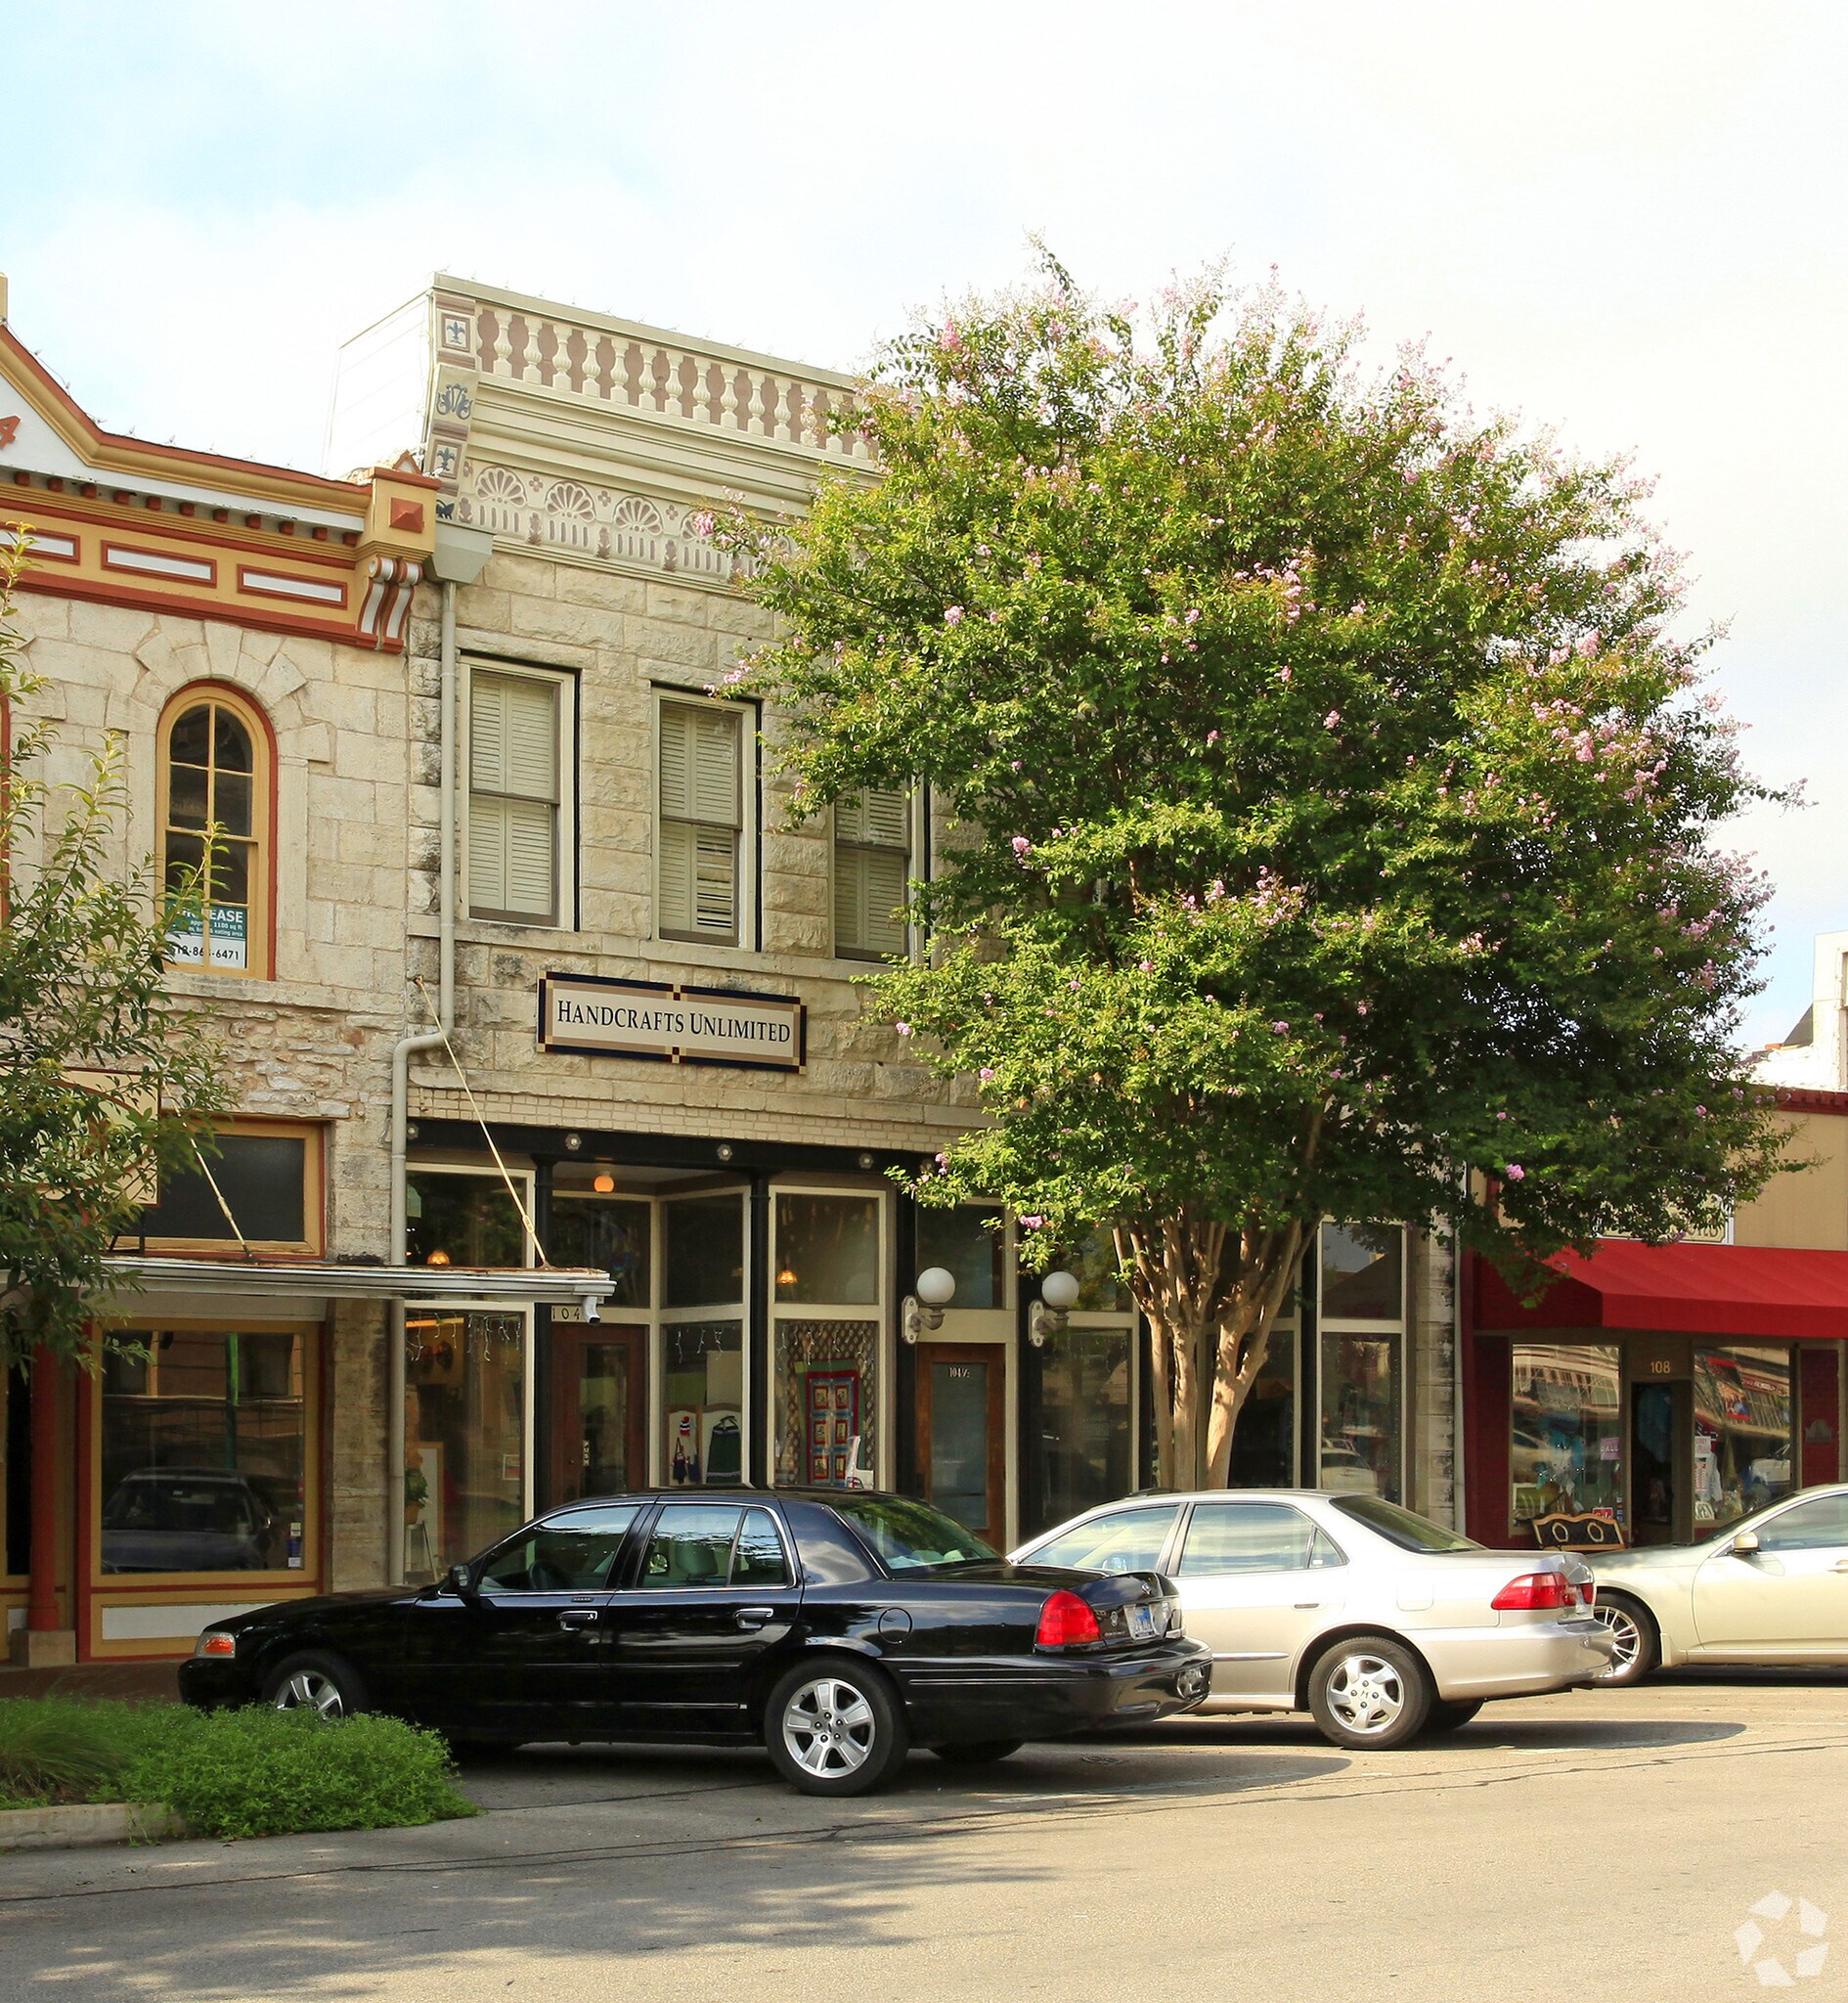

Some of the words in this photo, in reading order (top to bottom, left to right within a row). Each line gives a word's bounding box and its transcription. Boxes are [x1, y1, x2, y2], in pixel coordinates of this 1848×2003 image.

[171, 945, 239, 959] 12-86-6471
[557, 1000, 684, 1034] HANDCRAFTS
[689, 1012, 791, 1043] UNLIMITED
[552, 1308, 580, 1319] 104
[1650, 1359, 1671, 1374] 108
